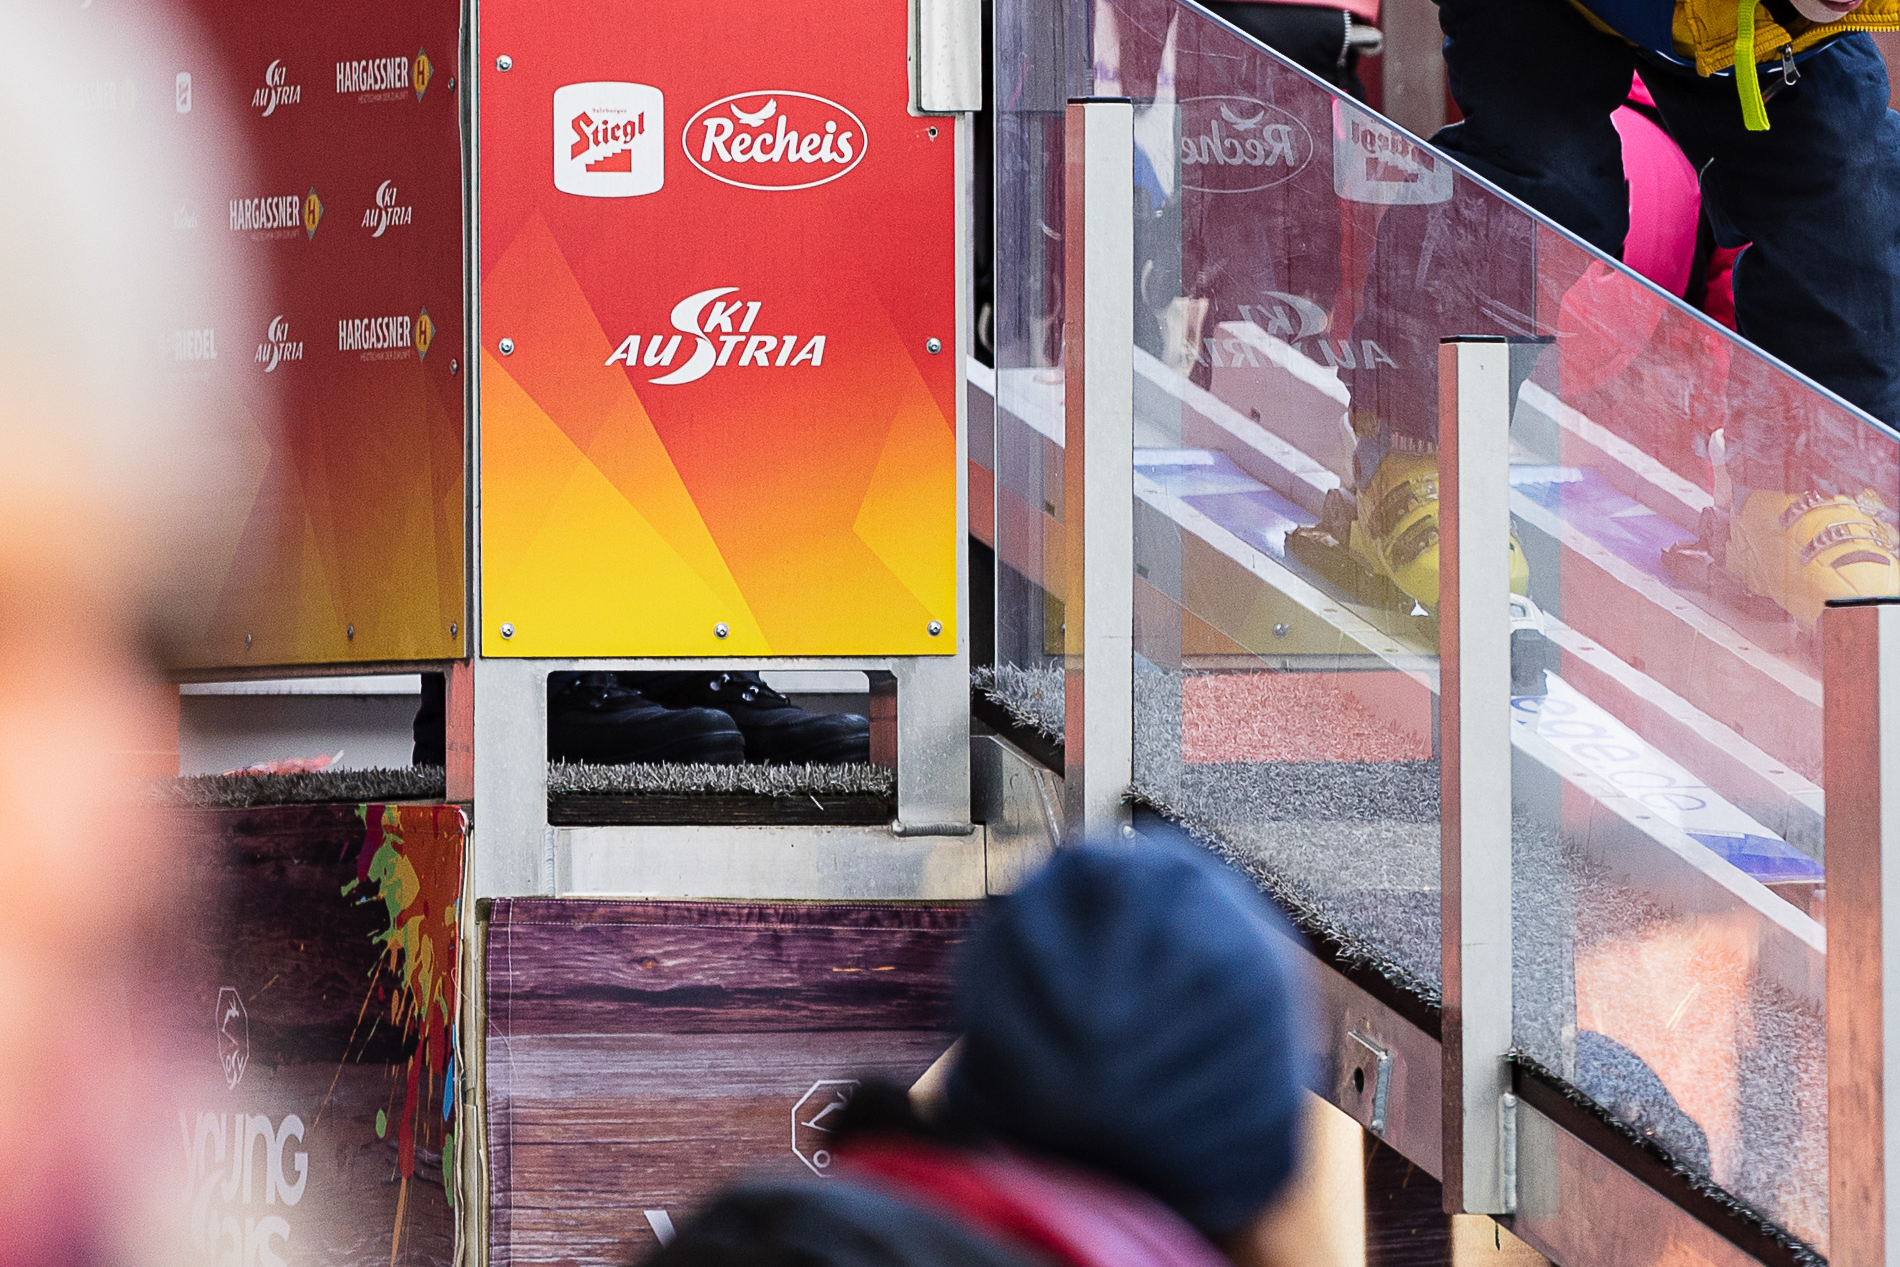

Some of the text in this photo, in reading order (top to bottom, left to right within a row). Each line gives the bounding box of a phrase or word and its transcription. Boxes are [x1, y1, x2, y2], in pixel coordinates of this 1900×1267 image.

[336, 57, 409, 94] HARGASSNER
[570, 110, 646, 162] Stiegl
[701, 115, 854, 164] Recheis
[229, 196, 300, 231] HARGASSNER
[338, 316, 411, 351] HARGASSNER
[670, 287, 762, 335] SKI
[604, 334, 827, 385] AUSTRIA
